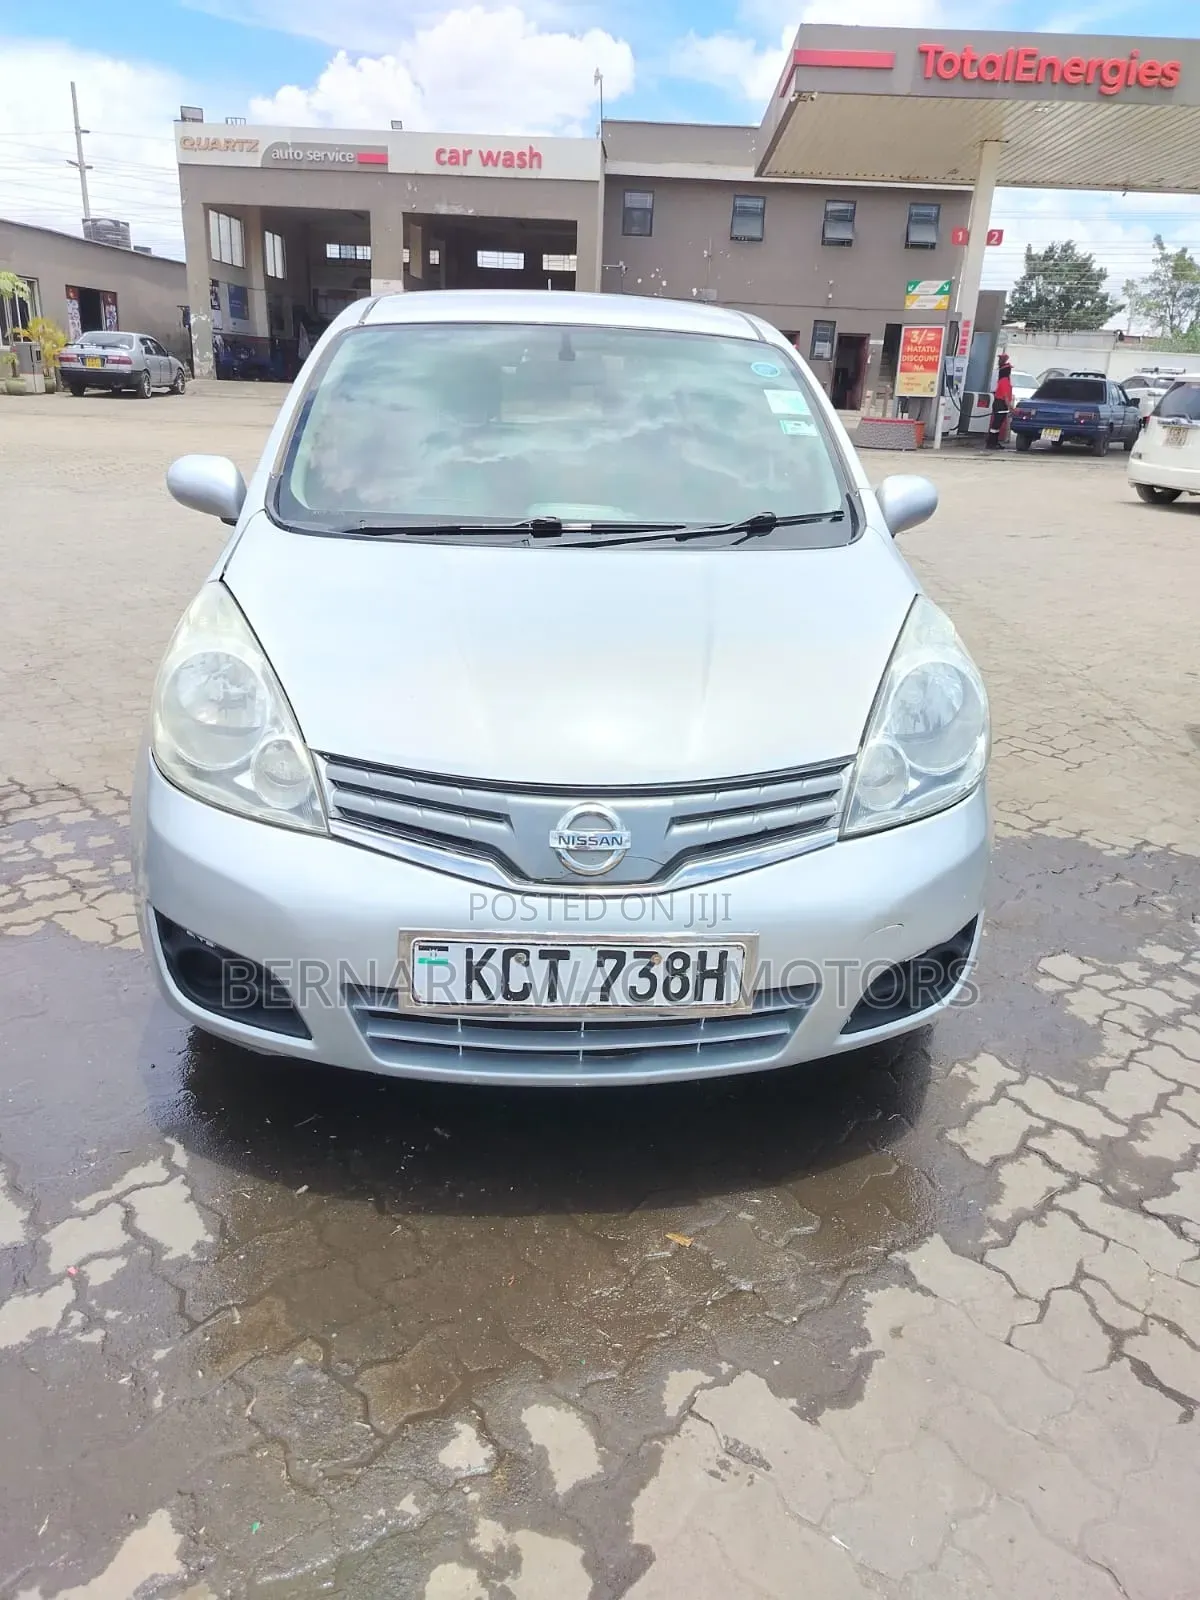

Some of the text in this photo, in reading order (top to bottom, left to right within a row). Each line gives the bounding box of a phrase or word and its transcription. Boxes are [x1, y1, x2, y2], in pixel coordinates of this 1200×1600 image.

[918, 44, 1181, 95] TotalEnergies
[180, 135, 260, 153] QUARTZ
[271, 142, 354, 163] auto service
[435, 144, 543, 169] car wash
[990, 231, 999, 245] 2
[902, 354, 939, 362] DISCOUNT
[558, 835, 623, 846] NISSAN
[465, 947, 728, 1003] KCT 738H
